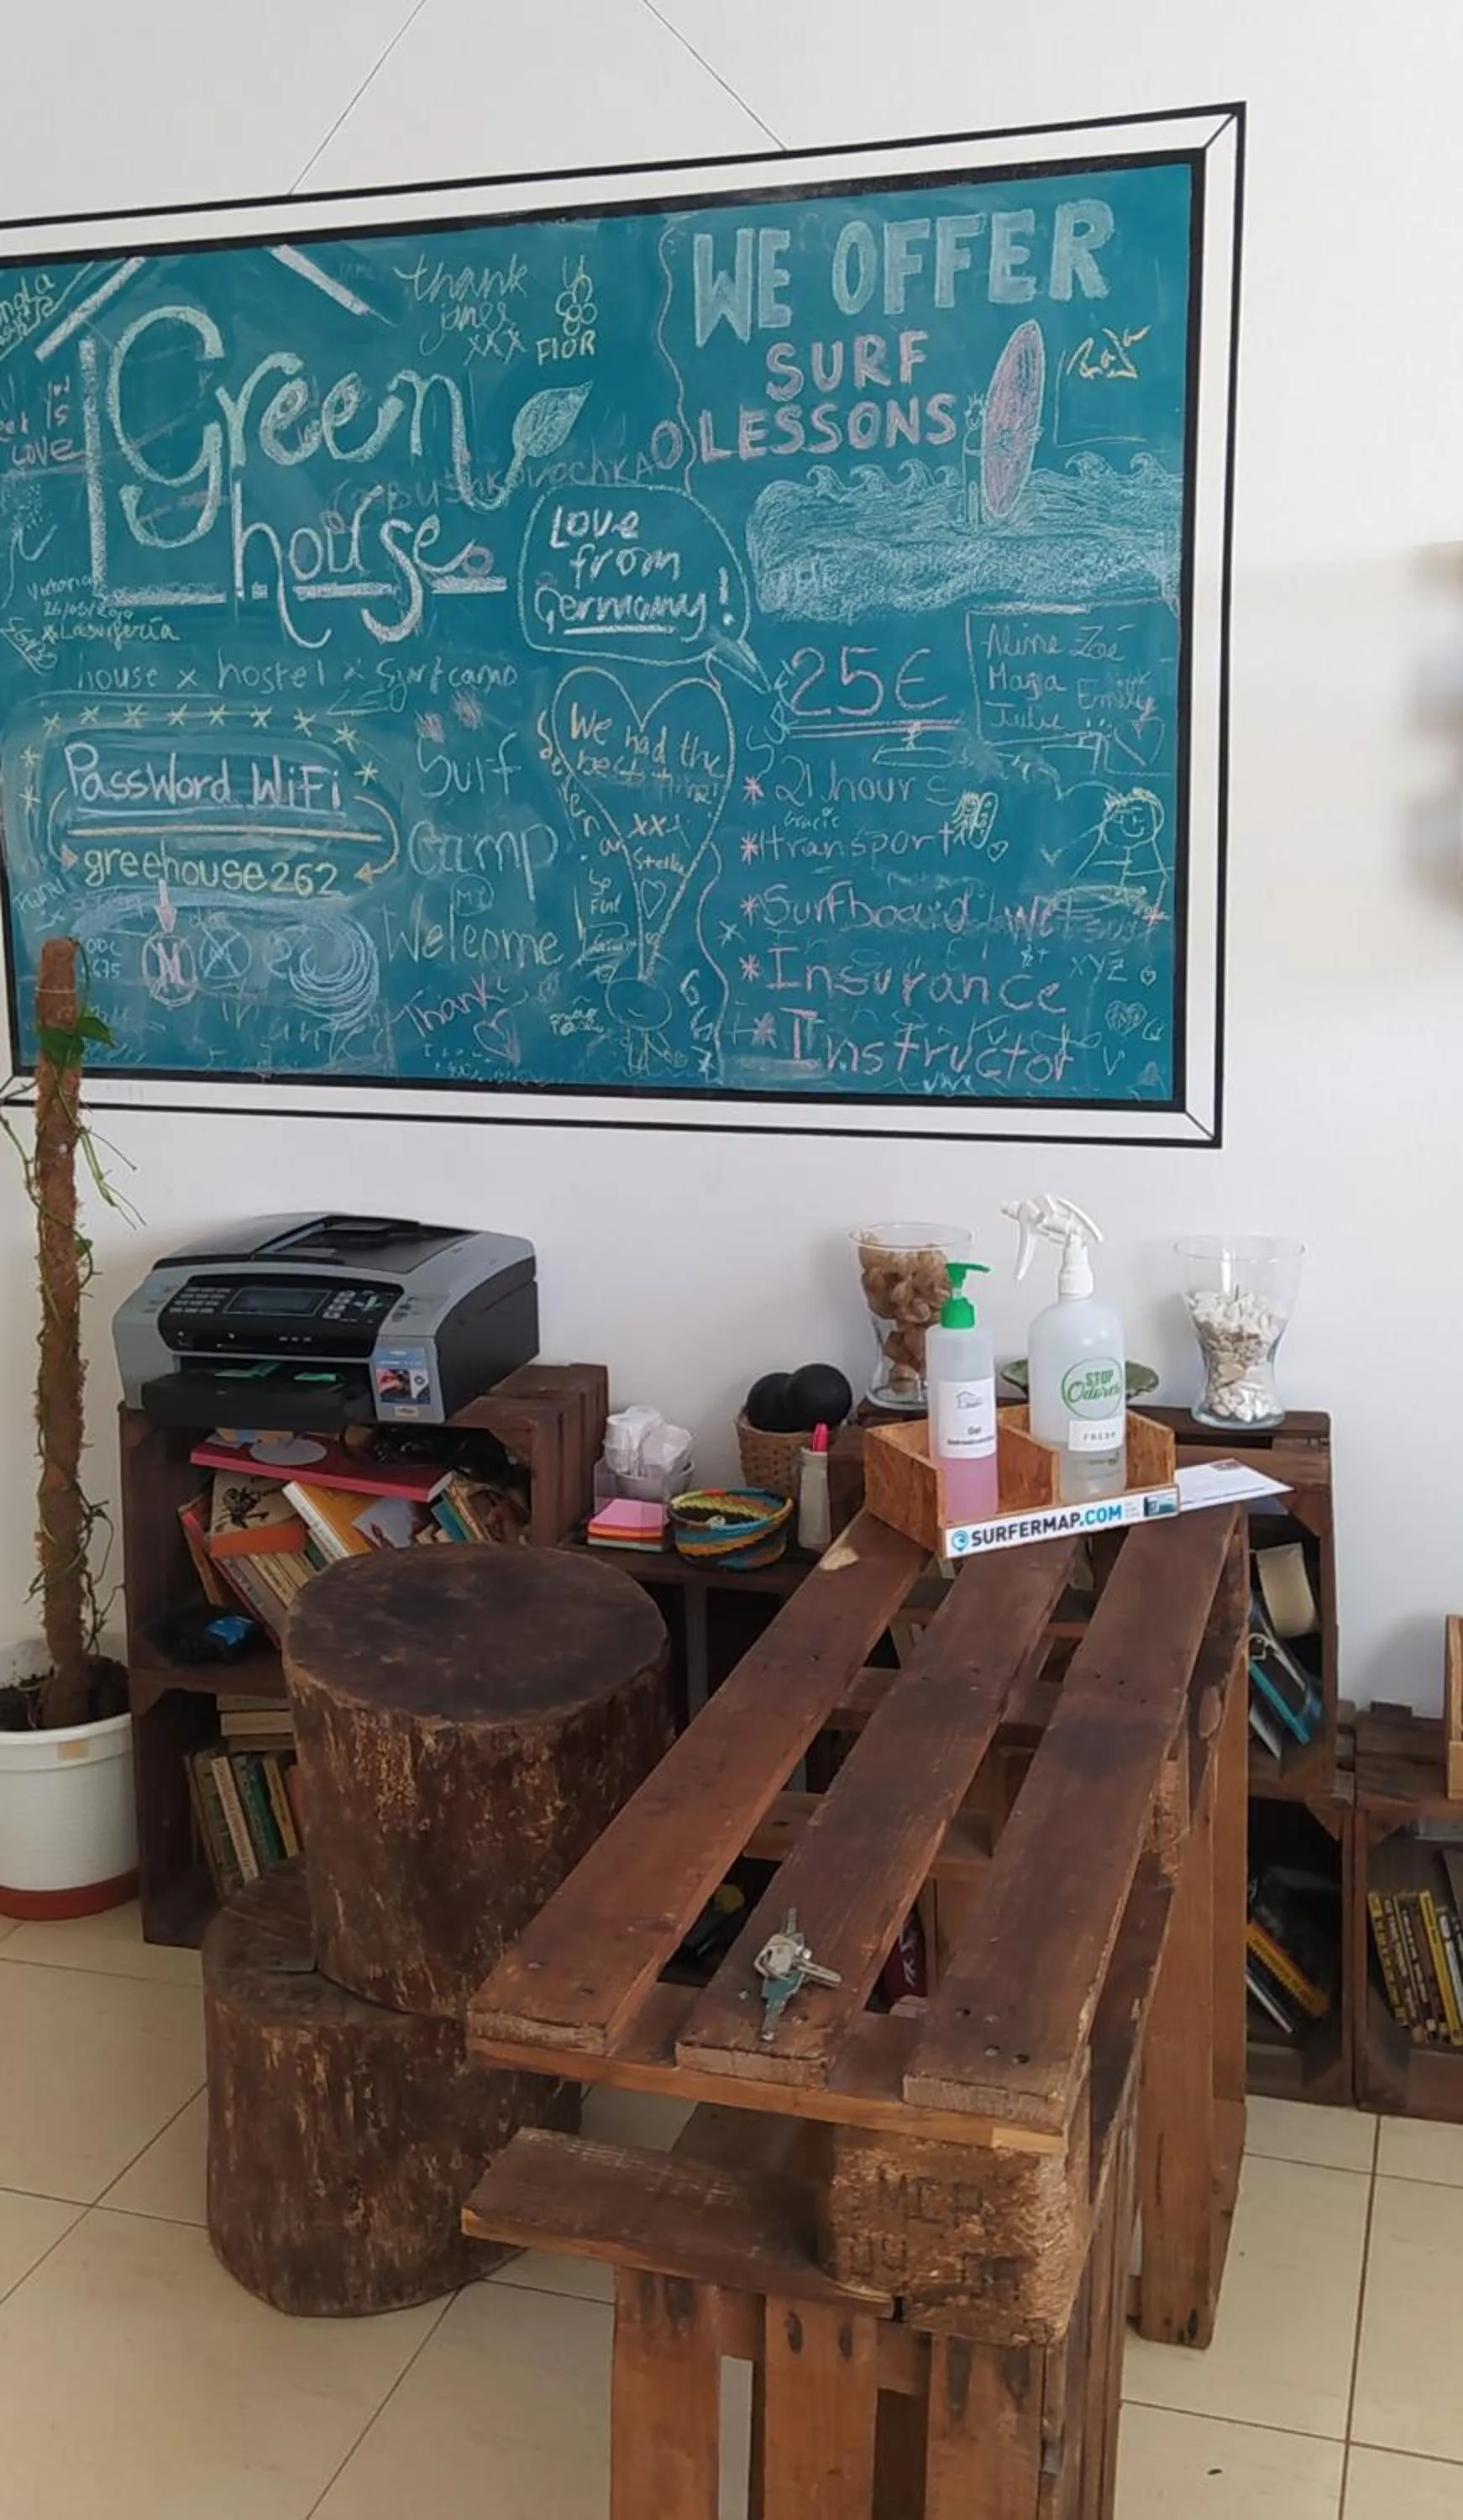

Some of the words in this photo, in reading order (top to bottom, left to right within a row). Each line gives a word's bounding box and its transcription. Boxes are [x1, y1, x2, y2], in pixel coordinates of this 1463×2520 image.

[693, 228, 792, 347] WE
[831, 199, 1114, 315] OFFER
[766, 331, 927, 402] SURF
[107, 305, 504, 548] Green
[700, 394, 957, 465] LESSONS
[233, 480, 475, 648] house
[569, 543, 681, 590] from
[217, 648, 326, 694] hostel
[408, 820, 558, 900] Camp
[382, 892, 564, 969] Welcome
[766, 946, 1067, 1014] Insurance
[779, 1007, 1075, 1084] Instructor
[971, 1504, 1123, 1547] SURFERMAP.COM
